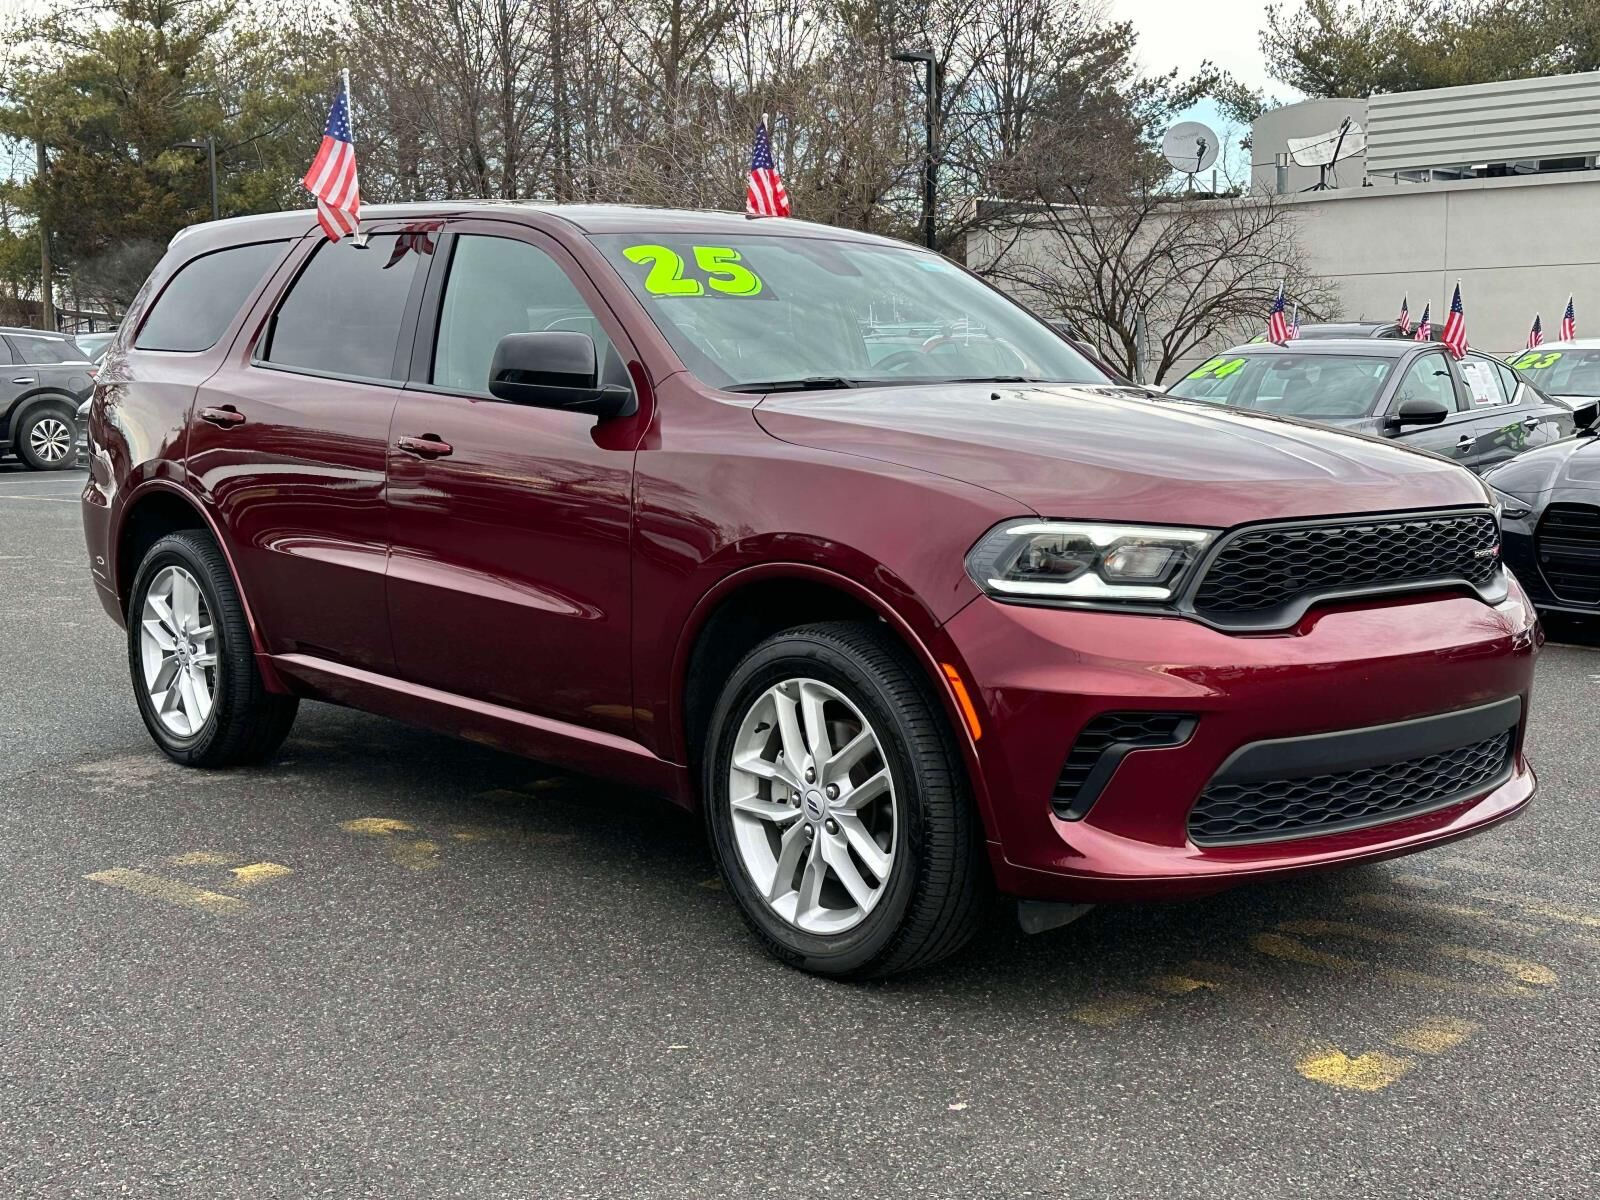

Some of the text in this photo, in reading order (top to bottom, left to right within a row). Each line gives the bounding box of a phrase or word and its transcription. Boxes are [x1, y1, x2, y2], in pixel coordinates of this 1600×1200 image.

[622, 245, 762, 296] 25
[1186, 358, 1246, 379] 24
[1513, 352, 1562, 369] 23
